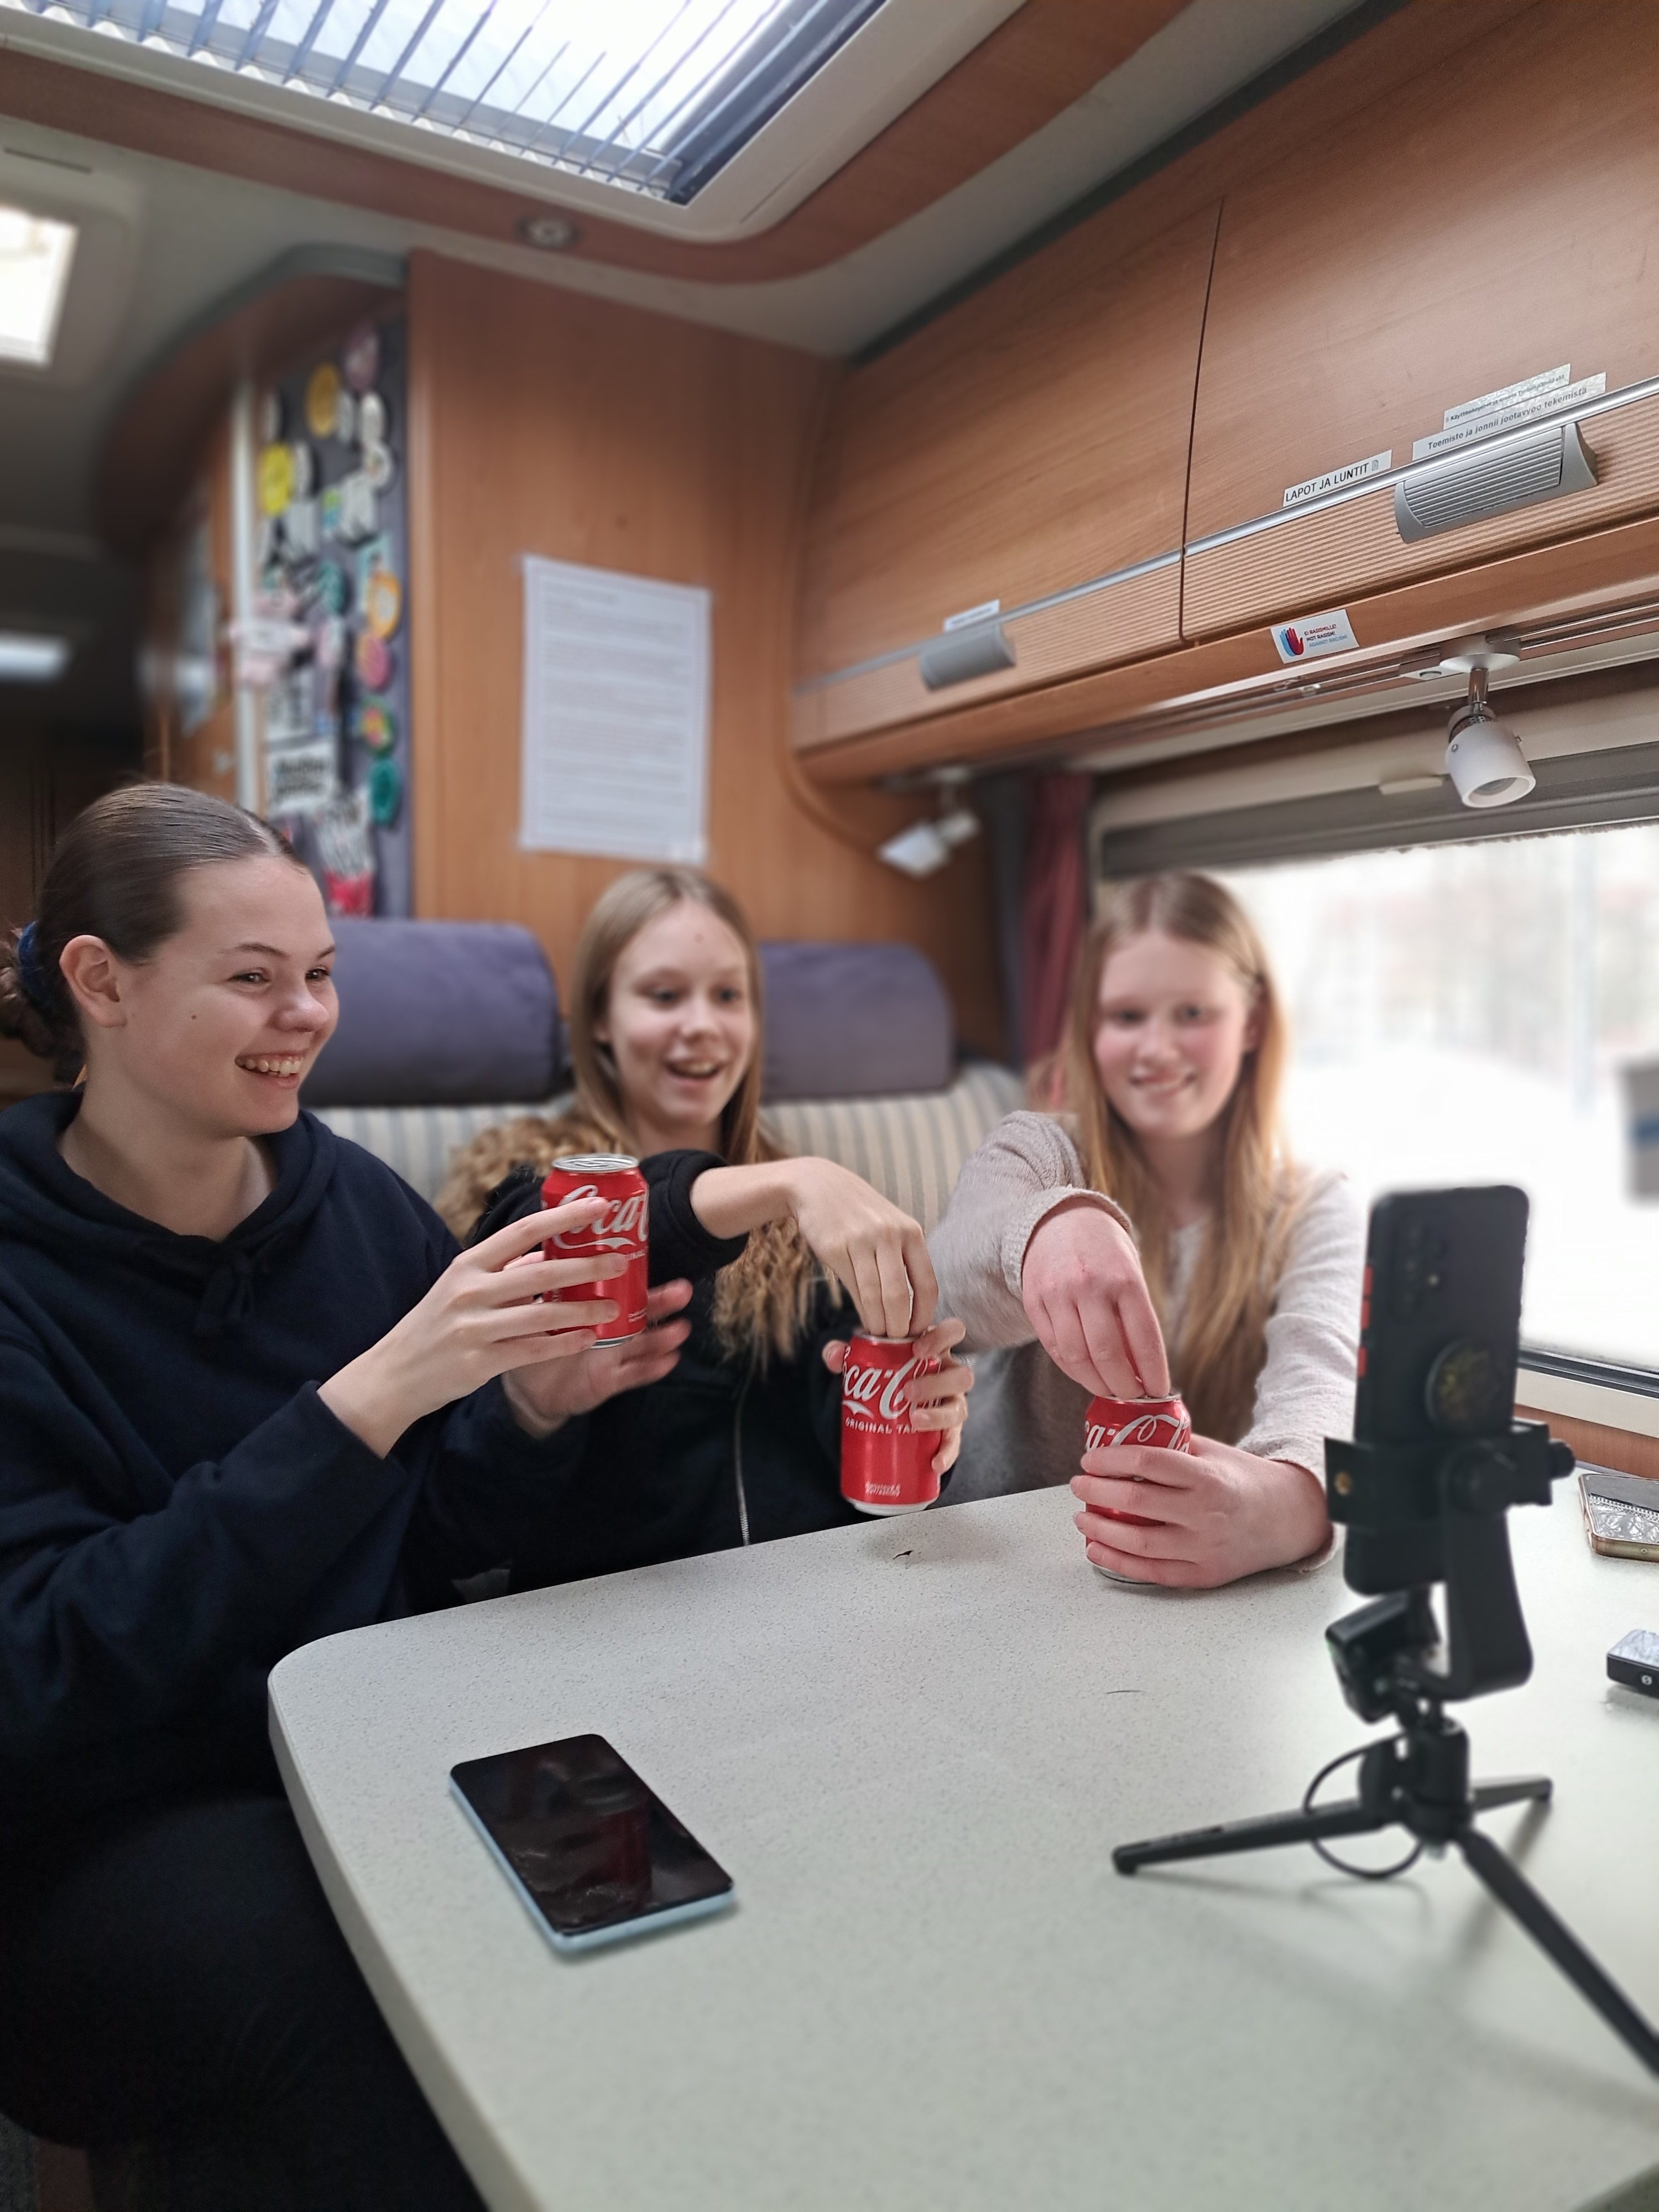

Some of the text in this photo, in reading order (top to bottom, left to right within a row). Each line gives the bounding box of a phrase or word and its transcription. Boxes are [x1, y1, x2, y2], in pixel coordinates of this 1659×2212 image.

[1428, 432, 1464, 450] Toemisto
[1465, 429, 1473, 437] ja
[1544, 387, 1587, 408] tekemistä
[1286, 462, 1369, 502] LAPOT JA LUNTIT
[1309, 624, 1337, 634] RASISMILLE!
[845, 1417, 893, 1434] ORIGINAL
